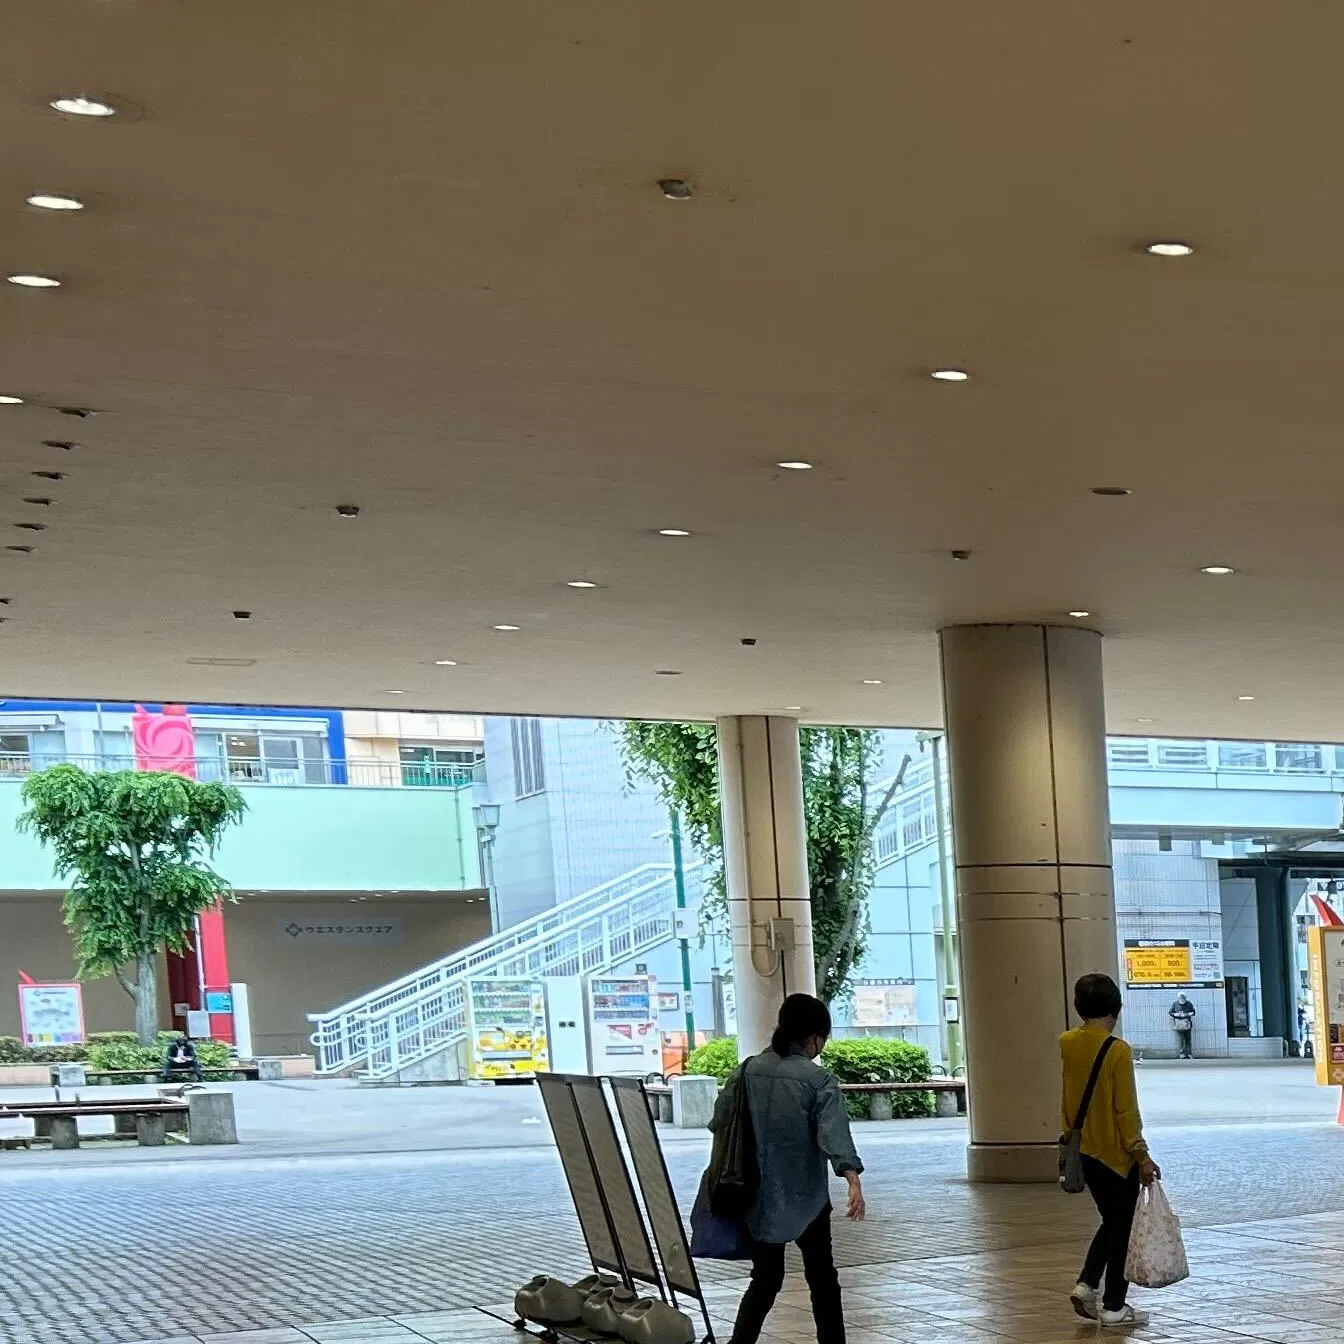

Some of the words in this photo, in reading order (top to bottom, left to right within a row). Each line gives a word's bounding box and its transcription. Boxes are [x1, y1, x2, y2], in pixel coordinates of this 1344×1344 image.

[305, 925, 393, 935] ウエスタンスクエア
